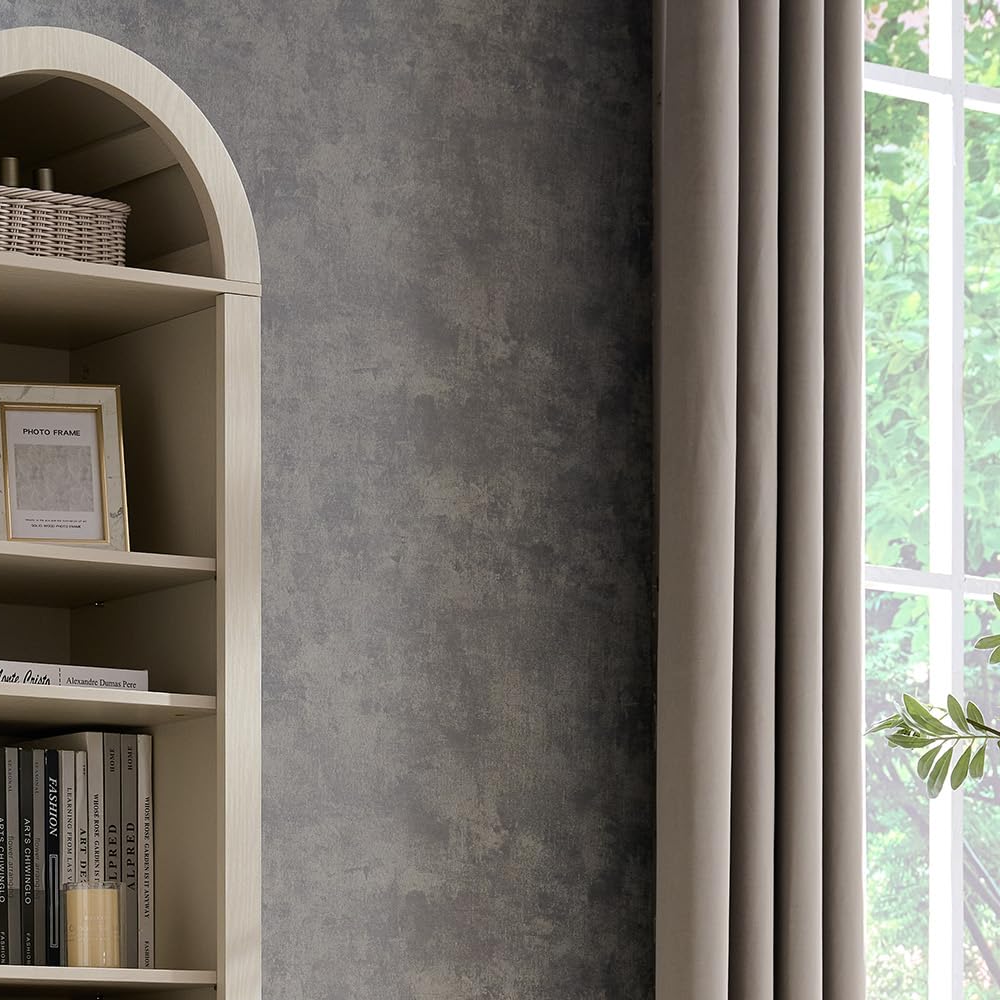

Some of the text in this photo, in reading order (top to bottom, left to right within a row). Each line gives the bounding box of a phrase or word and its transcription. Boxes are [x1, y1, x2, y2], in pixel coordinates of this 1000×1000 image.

[22, 428, 81, 437] PHOTO FRAME
[66, 677, 137, 689] Alexandre Dumas Pere
[49, 777, 58, 836] FASHION
[24, 848, 32, 905] CHIWINGLO
[109, 824, 118, 880] LPRED
[127, 822, 136, 890] ALPRED
